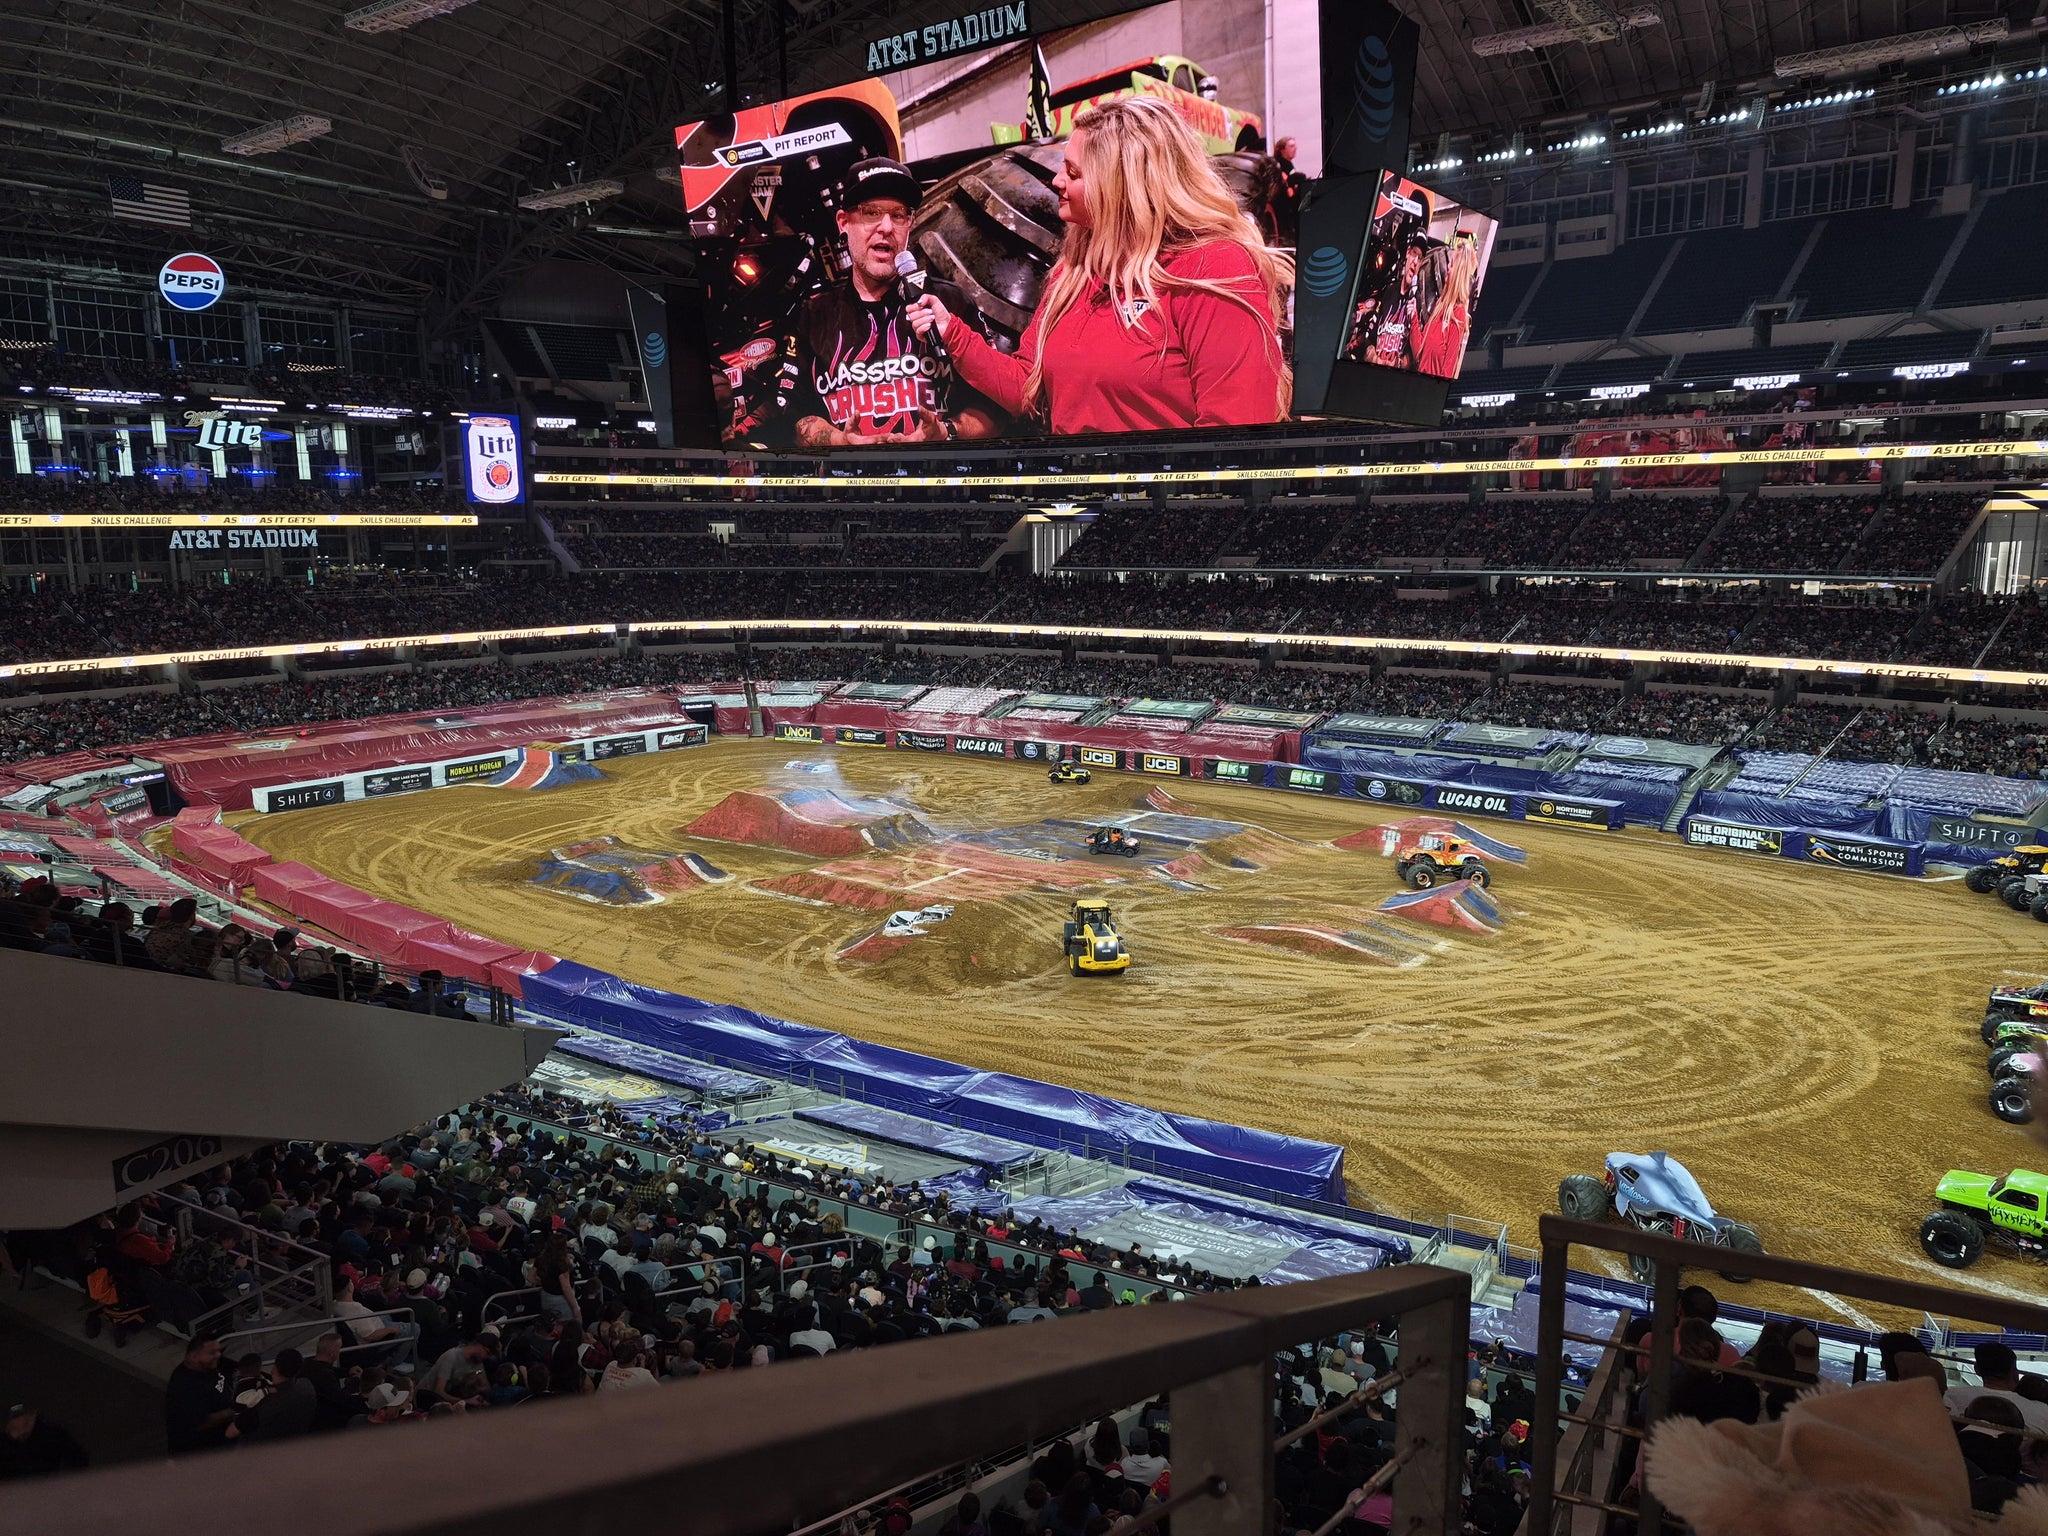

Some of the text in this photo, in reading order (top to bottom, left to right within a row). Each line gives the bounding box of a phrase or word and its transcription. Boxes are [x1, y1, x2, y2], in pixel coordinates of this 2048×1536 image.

[867, 0, 1027, 72] AT&T STADIUM
[775, 129, 836, 152] PIT REPORT
[163, 273, 220, 291] PEPSI
[816, 354, 954, 395] CLASSROOM
[1730, 415, 1754, 423] ALLEN
[1843, 410, 1853, 418] 94
[1902, 406, 1925, 415] WARE
[195, 418, 263, 451] Lite
[478, 434, 513, 458] Lite
[1886, 444, 2015, 456] AS AS IT GETS!
[1621, 457, 1635, 465] AS
[1652, 455, 1685, 463] GETS!
[1738, 450, 1826, 461] SKILLS CHALLENGE
[1465, 461, 1535, 471] SKILLS CHALLENGE
[91, 516, 173, 525] SKILLS CHALLENGE
[360, 516, 422, 525] SKILLS CHALLENGE
[169, 530, 319, 549] AT&T STADIUM
[784, 726, 812, 738] UNOH
[1336, 718, 1428, 731] LUCAS OIL
[956, 738, 1004, 753] LUCAS OIL
[1083, 751, 1114, 764] JCB
[1146, 757, 1178, 771] JCB
[449, 766, 473, 777] MORGAN
[479, 760, 502, 771] MORGAN
[1217, 762, 1249, 777] BKT
[1290, 770, 1324, 786] BKT
[277, 790, 332, 807] SHIFT 4
[1438, 791, 1507, 812] LUCAS OIL
[1555, 805, 1593, 816] NORTHERN
[1691, 823, 1765, 842] THE ORIGINAL
[1942, 824, 2015, 843] SHIFT 4
[1691, 832, 1758, 850] SUPER GLUE
[1837, 852, 1904, 867] COMMISSION
[1838, 845, 1905, 860] UTAH SPORTS
[121, 1136, 216, 1187] C206
[764, 1137, 884, 1171] MONSTER
[1619, 1180, 1650, 1206] MEGALODON
[1987, 1203, 2037, 1232] MAYHEM
